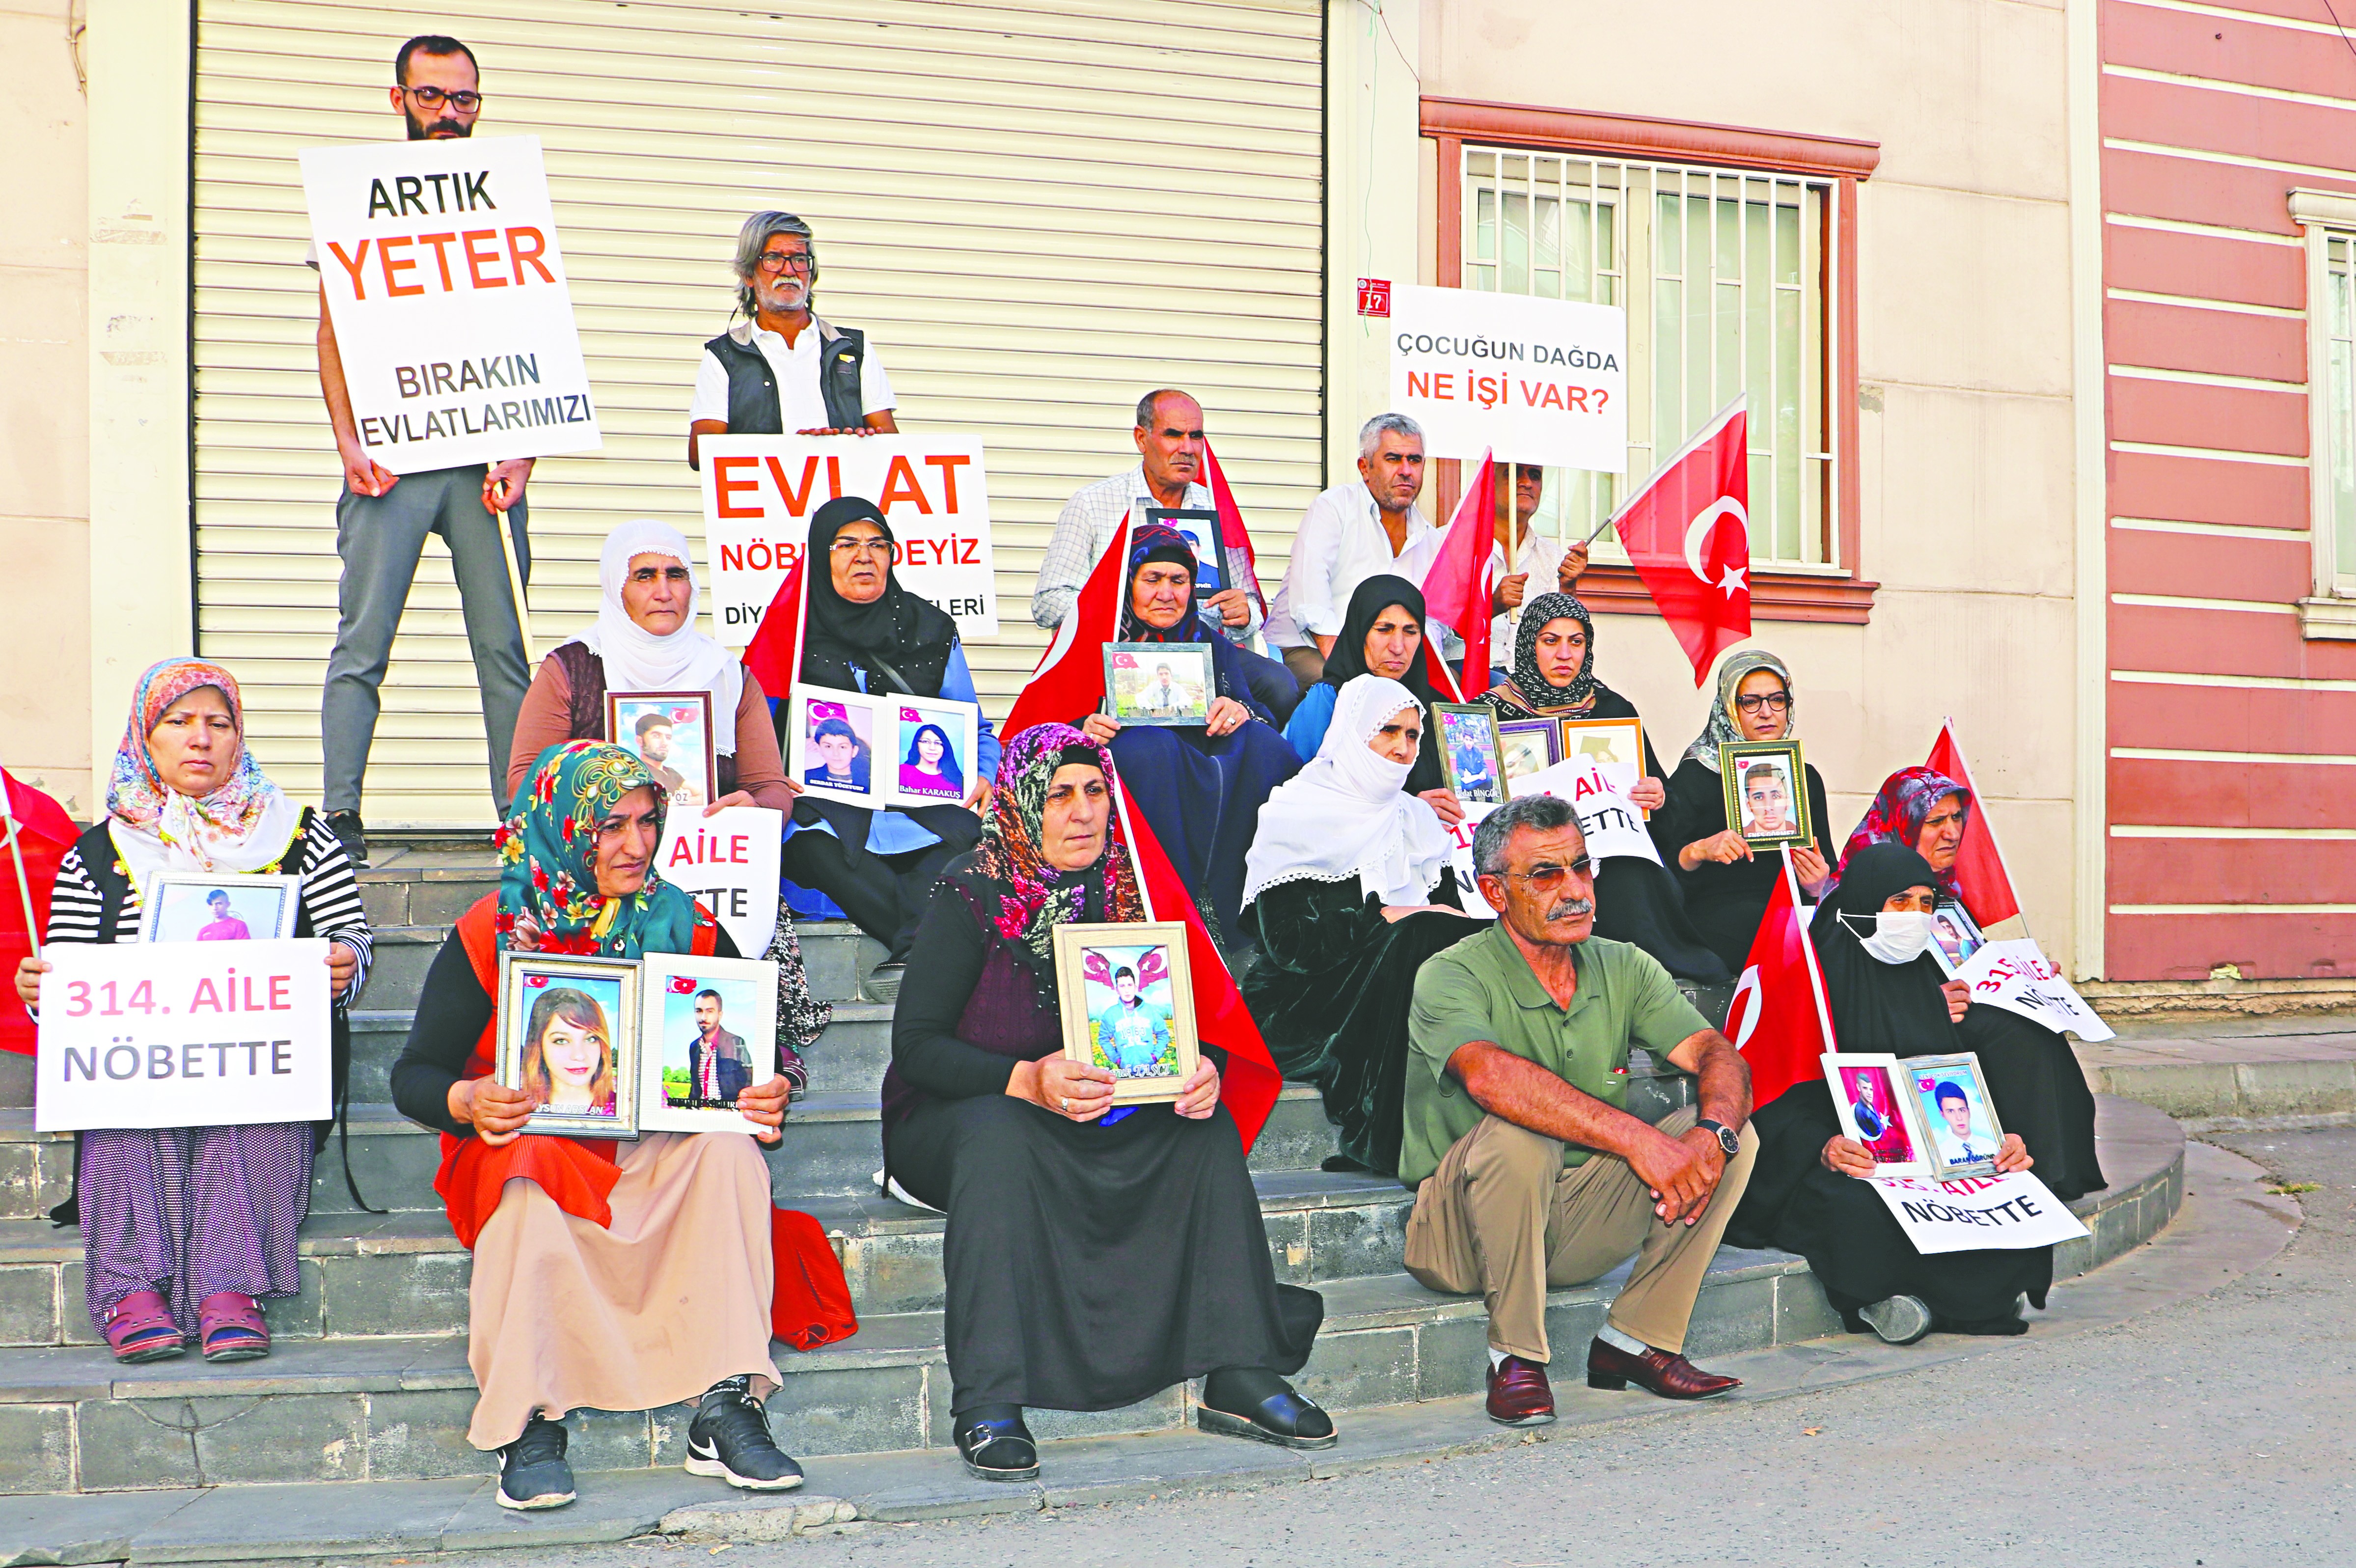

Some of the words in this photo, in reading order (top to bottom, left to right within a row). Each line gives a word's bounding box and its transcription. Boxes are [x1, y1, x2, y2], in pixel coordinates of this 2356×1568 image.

[368, 170, 497, 219] ARTIK
[326, 226, 557, 301] YETER
[1366, 294, 1382, 309] 17
[1397, 333, 1524, 361] ÇOCUĞUN
[1534, 345, 1619, 372] DAĞDA
[395, 353, 541, 399] BIRAKIN
[1408, 371, 1454, 400] NE
[1468, 369, 1507, 410] İŞİ
[1520, 380, 1609, 414] VAR?
[360, 393, 592, 447] EVLATLARIMIZI
[899, 785, 921, 794] Bahar
[922, 787, 961, 799] KARAKUŞ
[668, 828, 749, 867] AİLE
[65, 980, 171, 1017] 314.
[189, 967, 292, 1013] AİLE
[64, 1036, 292, 1081] NÖBETTE
[564, 1104, 604, 1115] ARSLAN
[1901, 1195, 2043, 1227] NÖBETTE
